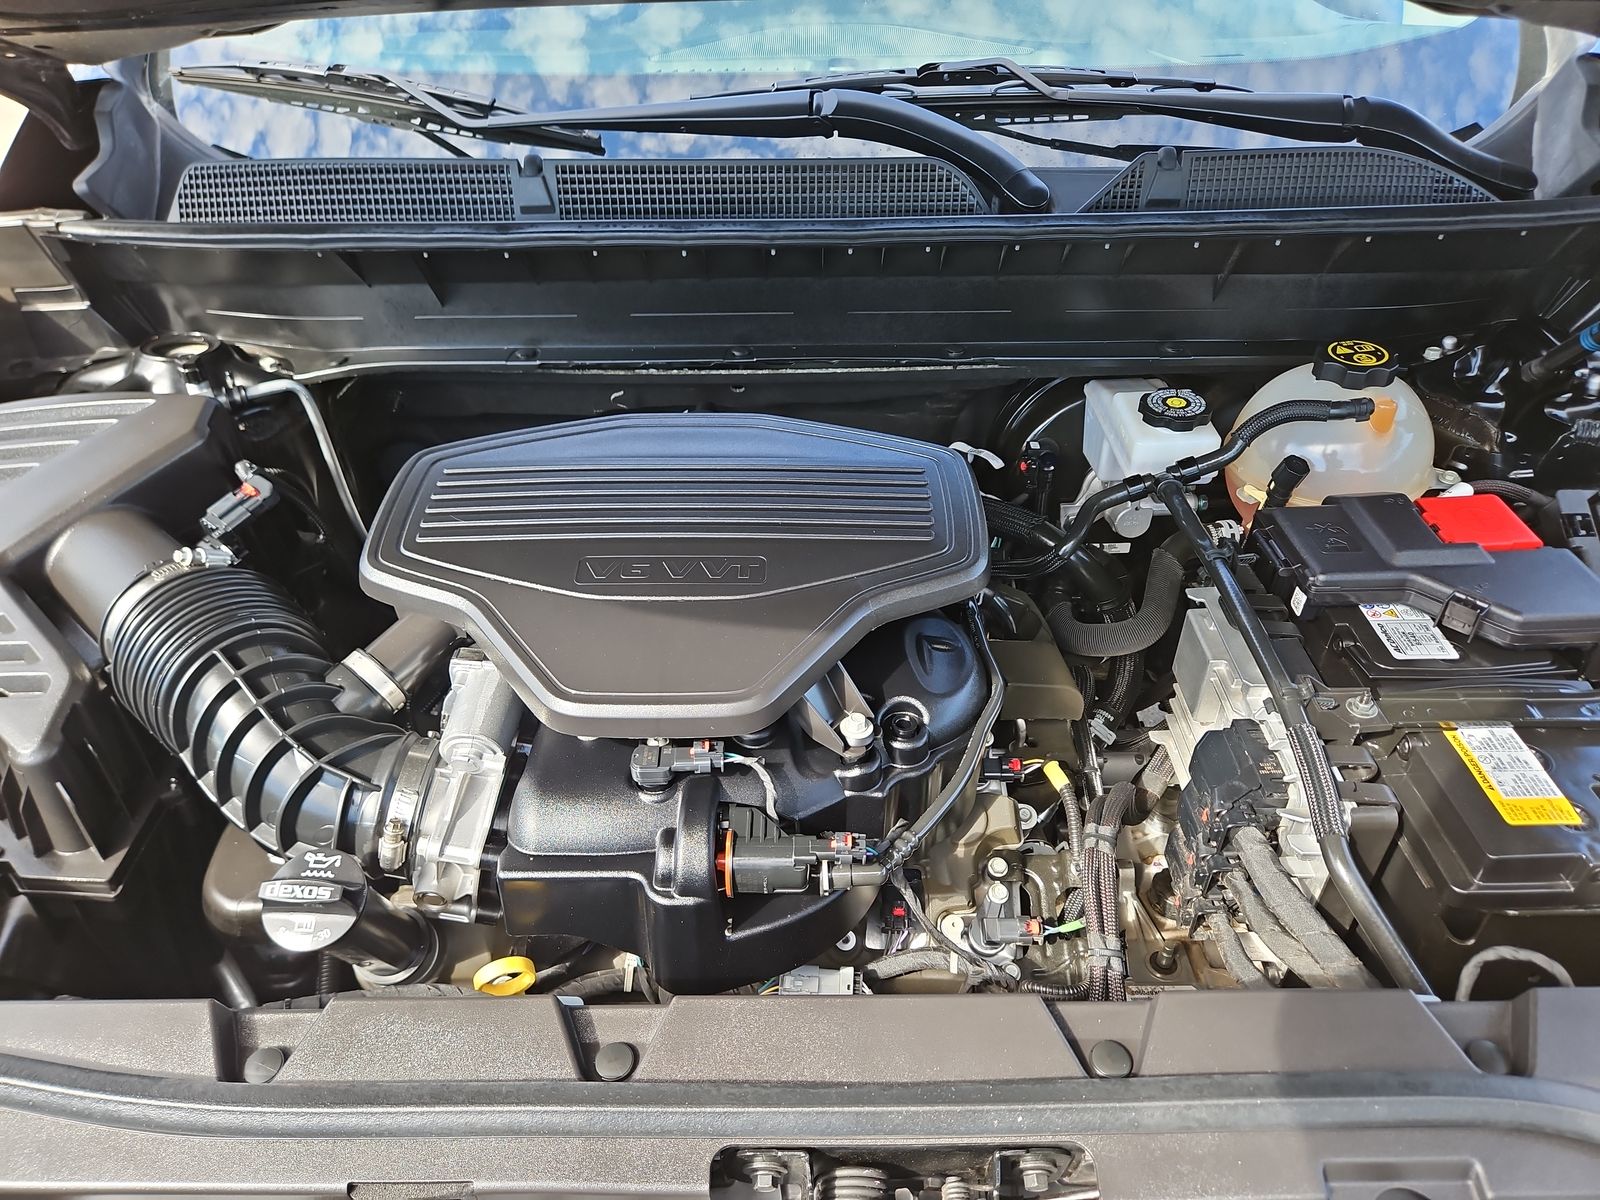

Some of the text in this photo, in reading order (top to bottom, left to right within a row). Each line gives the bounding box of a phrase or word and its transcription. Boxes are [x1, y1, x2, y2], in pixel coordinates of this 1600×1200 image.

[585, 560, 760, 579] V6 VVT
[1377, 622, 1403, 654] ACDelco
[1451, 734, 1490, 785] DANGER POISON
[265, 881, 335, 900] dexos
